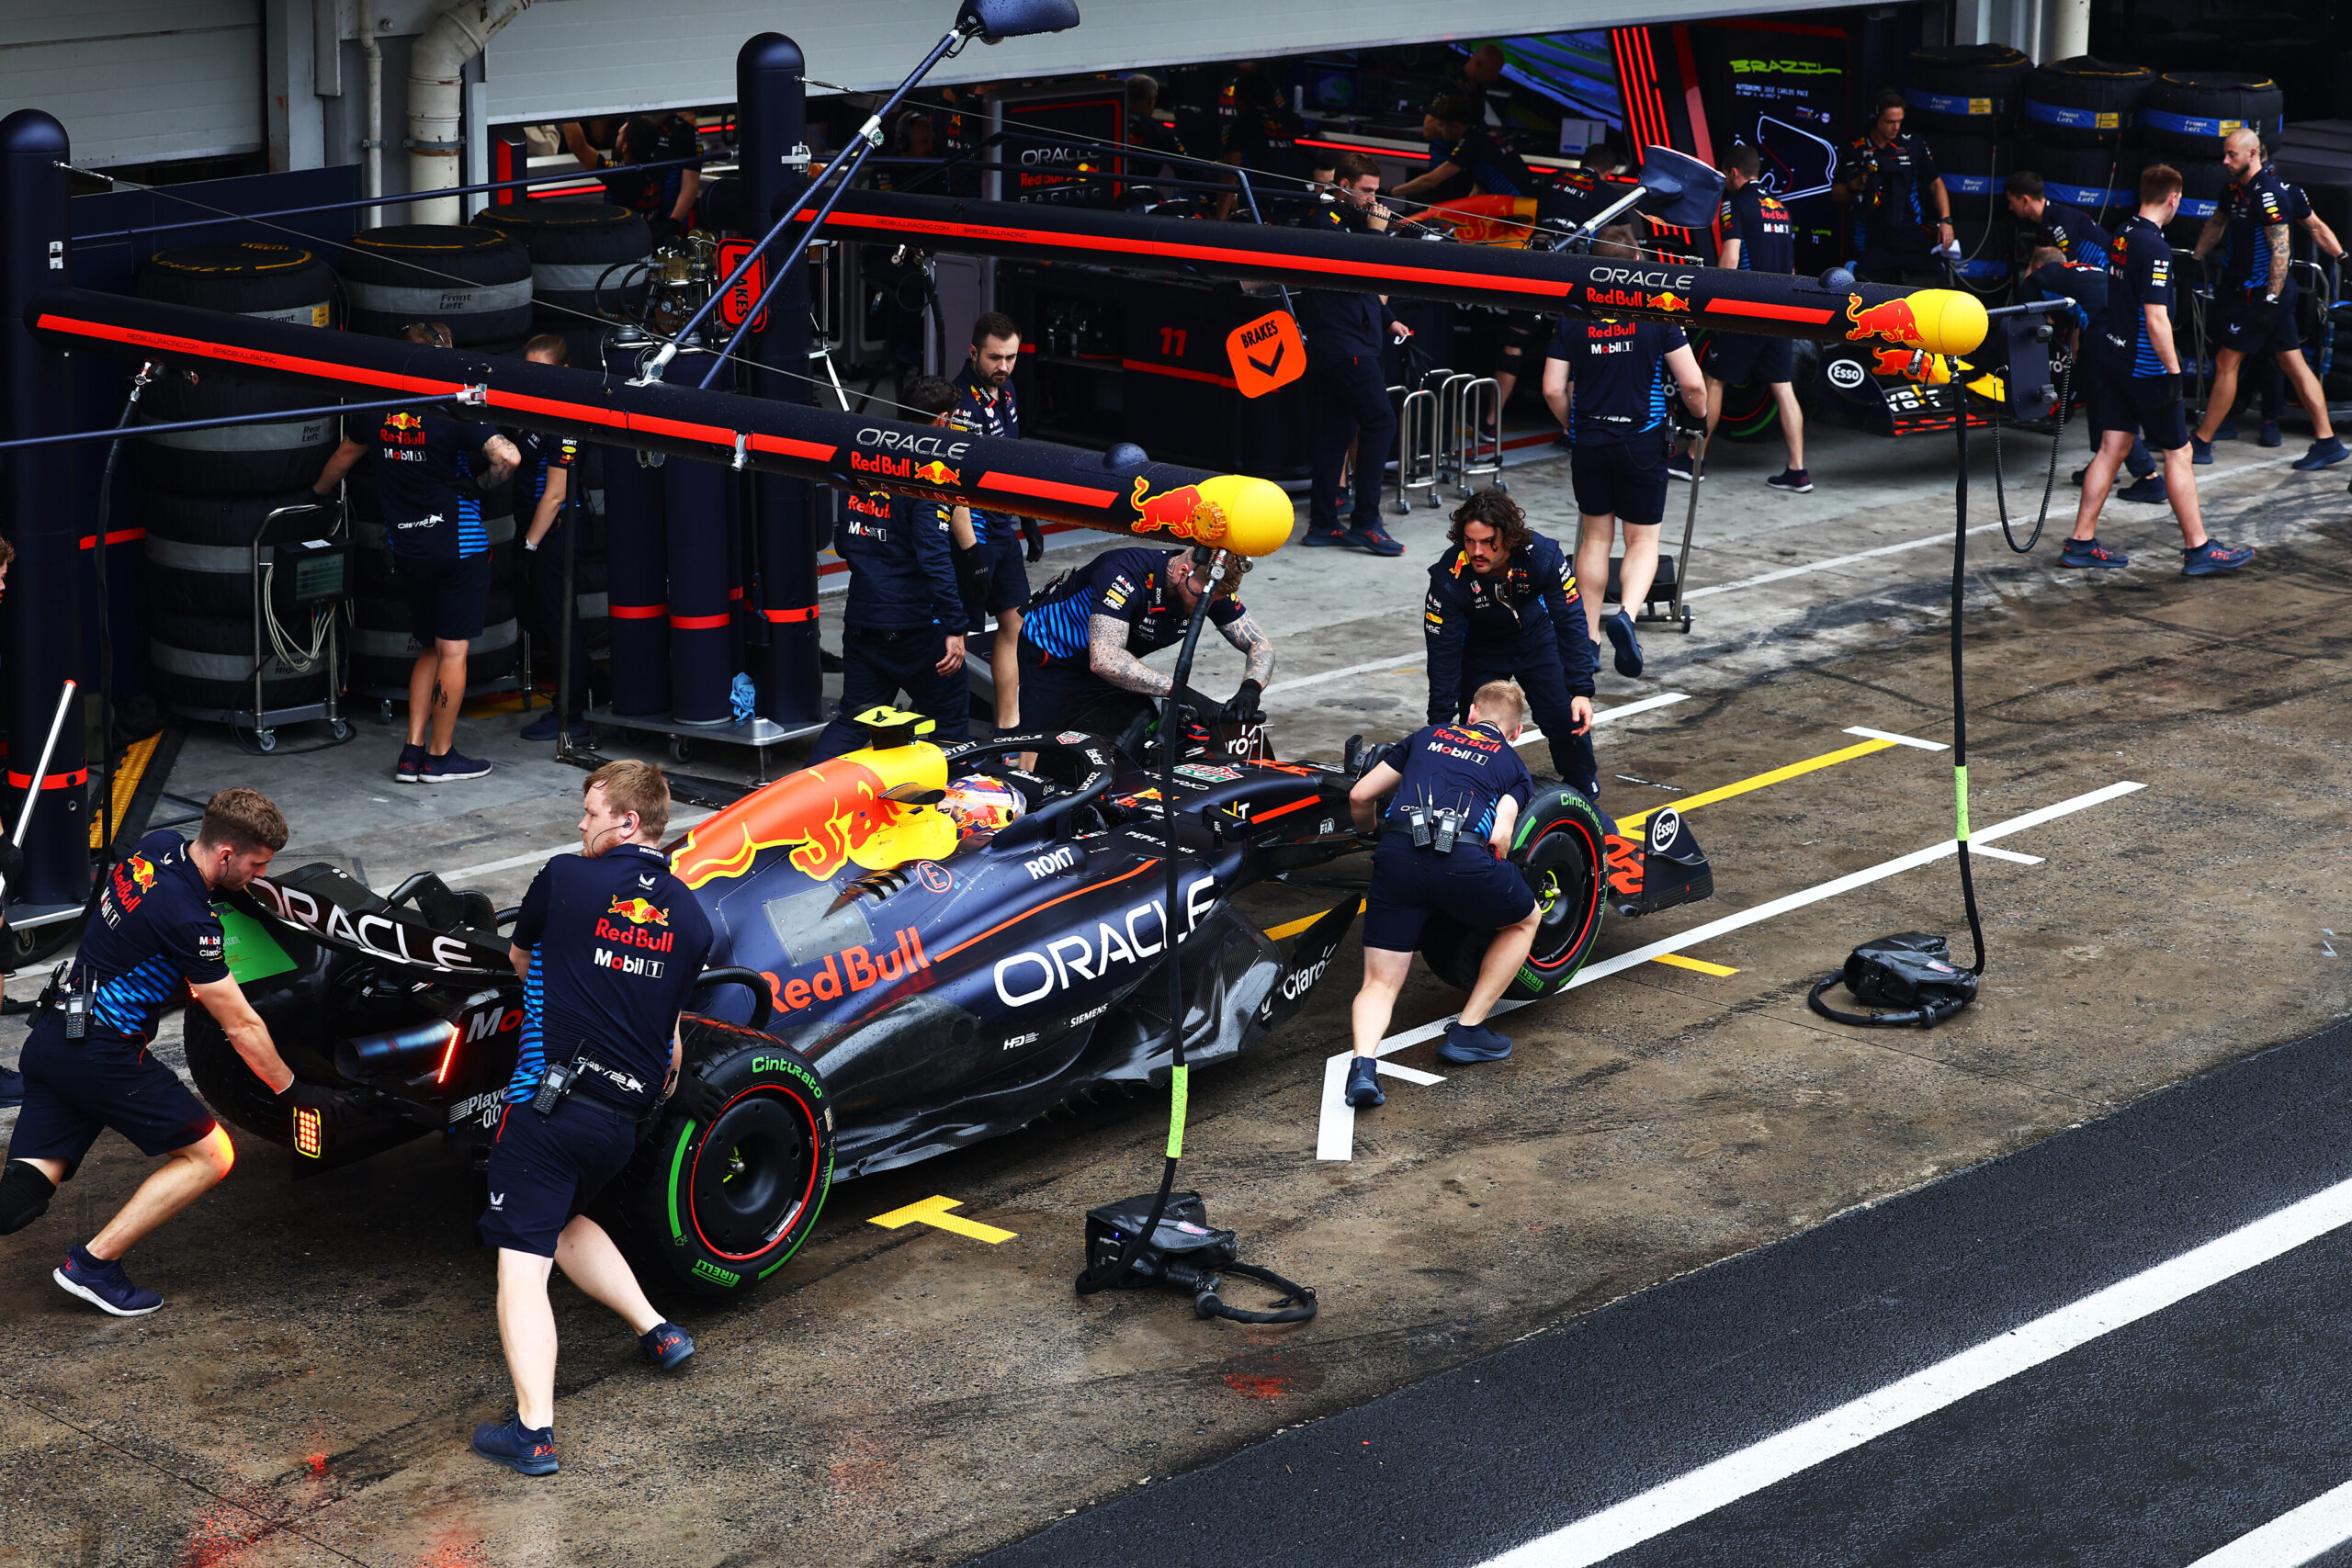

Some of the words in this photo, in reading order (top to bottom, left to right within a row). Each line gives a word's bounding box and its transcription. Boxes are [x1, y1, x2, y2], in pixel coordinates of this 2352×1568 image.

[1729, 60, 1842, 74] BRAZIL
[2058, 110, 2080, 118] Front
[1021, 173, 1042, 186] Red
[1020, 187, 1101, 204] RACING
[876, 219, 950, 231] REDBULLRACING.COM
[1763, 223, 1784, 233] Mobil
[1589, 266, 1696, 290] ORACLE
[441, 294, 472, 302] Front
[1587, 288, 1614, 305] Red
[1615, 290, 1644, 308] Bull
[1240, 319, 1280, 349] BRAKES
[1588, 325, 1612, 338] Red
[1613, 322, 1636, 336] Bull
[126, 333, 199, 351] REDBULLRACING.COM
[1159, 326, 1188, 356] 11
[1590, 342, 1622, 355] Mobil
[301, 434, 319, 443] Left
[302, 425, 322, 434] Rear
[403, 432, 425, 446] Bull
[856, 427, 971, 459] ORACLE
[383, 447, 413, 461] Mobil
[851, 450, 880, 473] Red
[881, 456, 910, 478] Bull
[856, 478, 970, 505] RACING
[847, 495, 873, 514] Red
[1111, 581, 1130, 598] Claro
[1115, 574, 1136, 593] Mobil
[1102, 596, 1123, 610] HRC
[993, 734, 1043, 743] ORACLE
[1432, 728, 1468, 745] Red
[1468, 739, 1503, 754] Bull
[1427, 741, 1472, 761] Mobil
[1561, 793, 1604, 836] Cinturato
[1320, 818, 1335, 834] FIA
[1657, 819, 1676, 840] Esso
[1125, 830, 1159, 842] PEPE
[1156, 840, 1195, 853] JNS
[639, 847, 664, 859] HONDA
[1023, 846, 1075, 881] ROKT
[113, 862, 133, 892] Red
[100, 886, 113, 918] Mobil
[117, 885, 142, 913] Bull
[243, 877, 487, 971] ORACLE
[594, 918, 635, 945] Red
[636, 928, 674, 953] Bull
[993, 874, 1216, 1008] ORACLE
[198, 948, 220, 957] Claro
[594, 948, 645, 976] Mobil
[759, 954, 843, 1013] Red
[840, 926, 932, 993] Bull
[1283, 960, 1326, 1000] Claro
[1070, 1003, 1108, 1028] SIEMENS
[752, 1055, 822, 1100] Cinturato
[467, 1086, 509, 1116] Playe
[691, 1258, 741, 1288] PIRELLI
